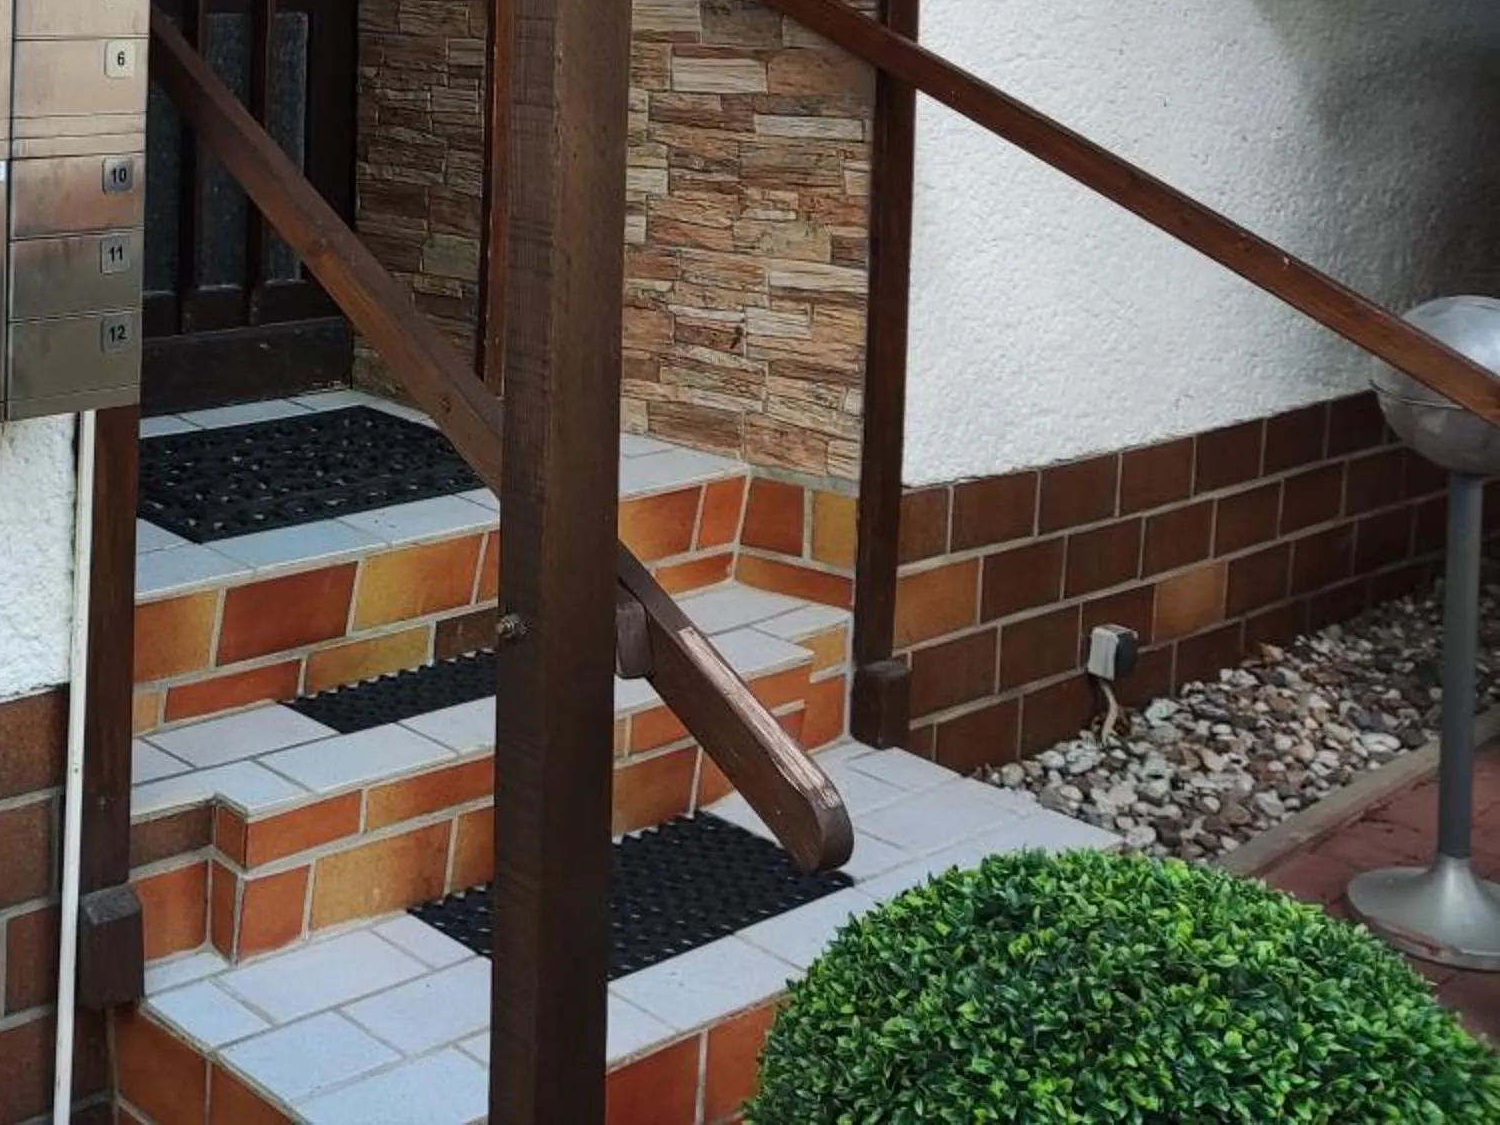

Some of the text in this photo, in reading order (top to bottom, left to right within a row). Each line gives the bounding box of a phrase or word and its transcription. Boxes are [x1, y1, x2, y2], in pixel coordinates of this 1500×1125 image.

[117, 51, 125, 66] 6
[111, 168, 127, 183] 10
[110, 246, 122, 261] 11
[110, 325, 127, 342] 12
